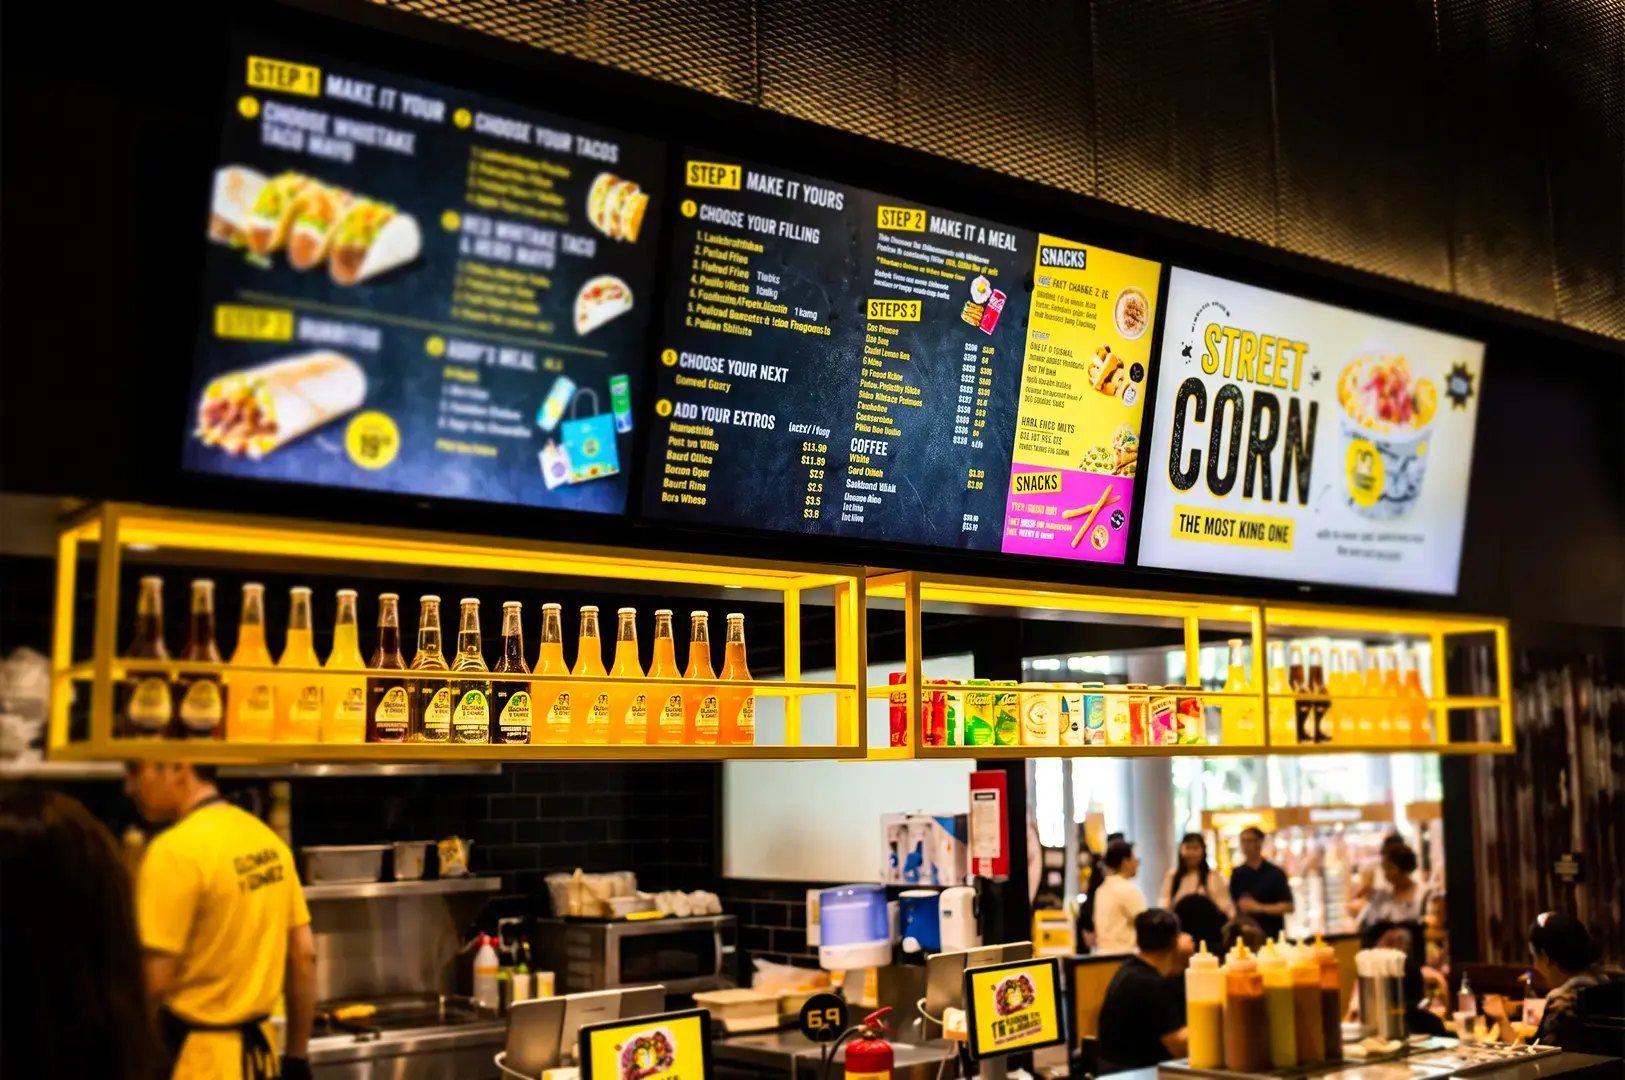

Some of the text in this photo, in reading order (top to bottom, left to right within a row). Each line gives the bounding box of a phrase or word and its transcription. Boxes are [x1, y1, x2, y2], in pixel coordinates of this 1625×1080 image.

[253, 62, 303, 91] STEP
[326, 74, 446, 122] MAKE IT YOUR
[535, 126, 572, 151] YOUR
[577, 135, 619, 163] TACOS
[690, 166, 844, 211] STEP 1 MAKE IT YOURS
[700, 204, 744, 228] CHOOSE
[748, 214, 776, 235] YOUR
[779, 222, 820, 244] FILLING
[882, 210, 1018, 252] STEP 2 MAKE IT A MEAL
[1042, 248, 1085, 268] SNACKS
[871, 302, 917, 318] STEPS 3
[679, 353, 725, 374] CHOOSE
[728, 360, 756, 379] YOUR
[760, 366, 789, 383] NEXT
[1200, 322, 1309, 392] STREET
[673, 402, 699, 419] ADD
[701, 407, 730, 425] YOUR
[733, 411, 776, 430] EXTROS
[850, 438, 888, 456] COFFEE
[1168, 377, 1319, 507] CORN
[1016, 474, 1058, 492] SNACKS
[1179, 513, 1290, 544] THE MOST KING ONE
